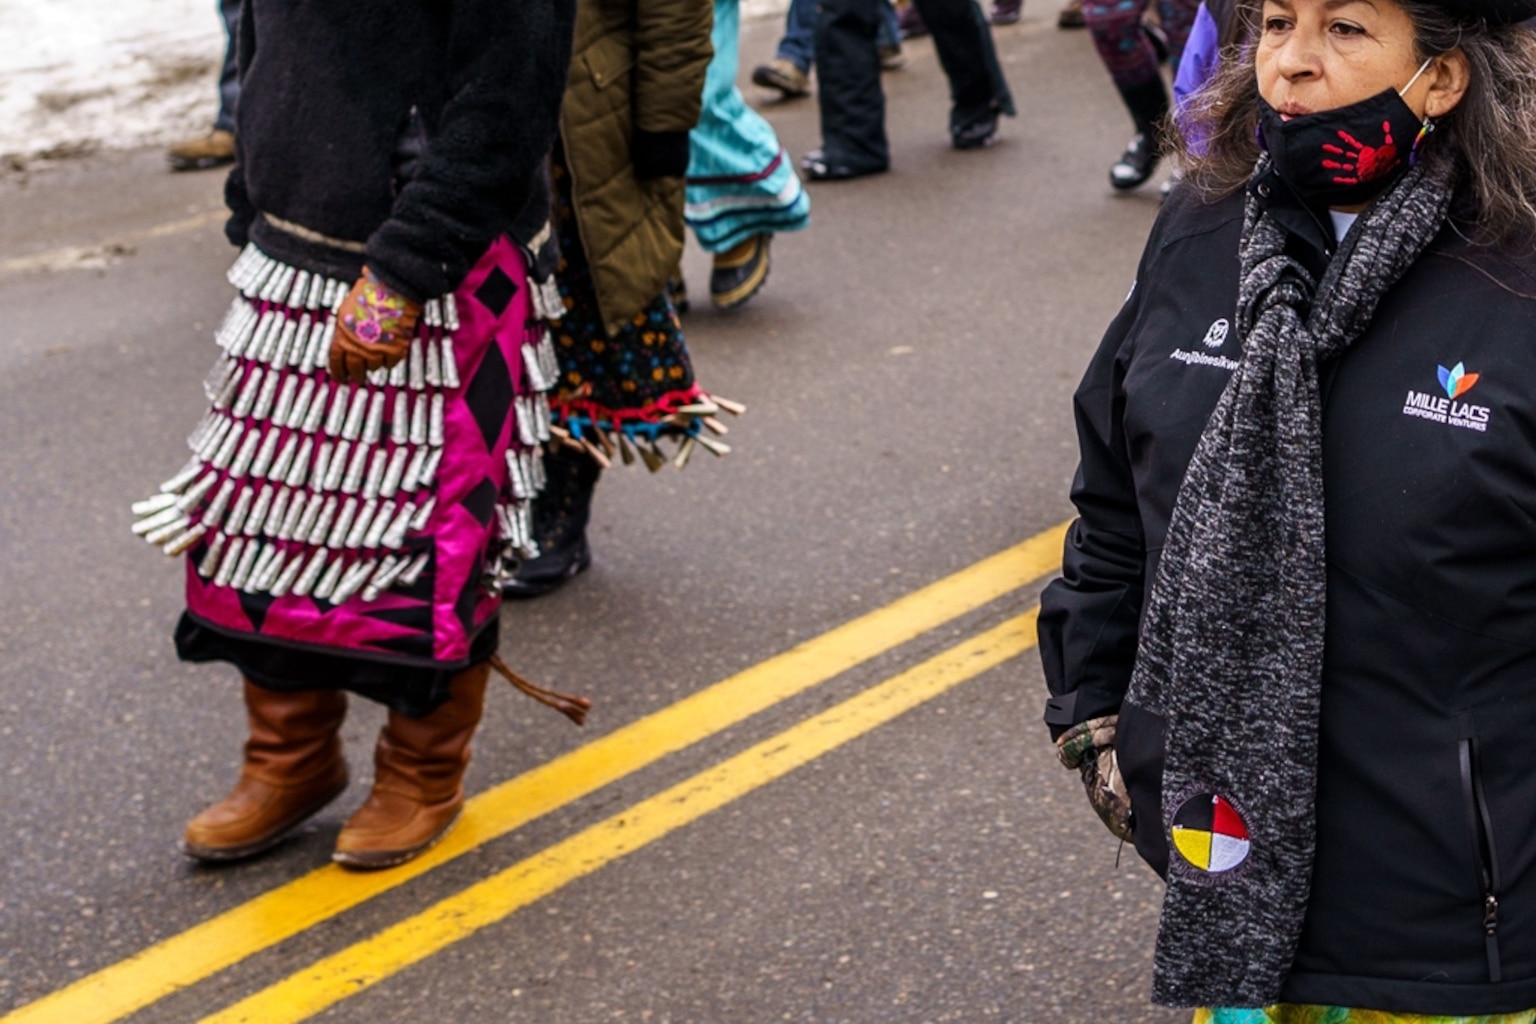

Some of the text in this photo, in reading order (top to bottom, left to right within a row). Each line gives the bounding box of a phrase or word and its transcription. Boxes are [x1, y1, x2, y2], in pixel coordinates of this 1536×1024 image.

[1402, 405, 1488, 432] CORPORATE VENTURES
[1405, 390, 1491, 423] MILLE LACS
